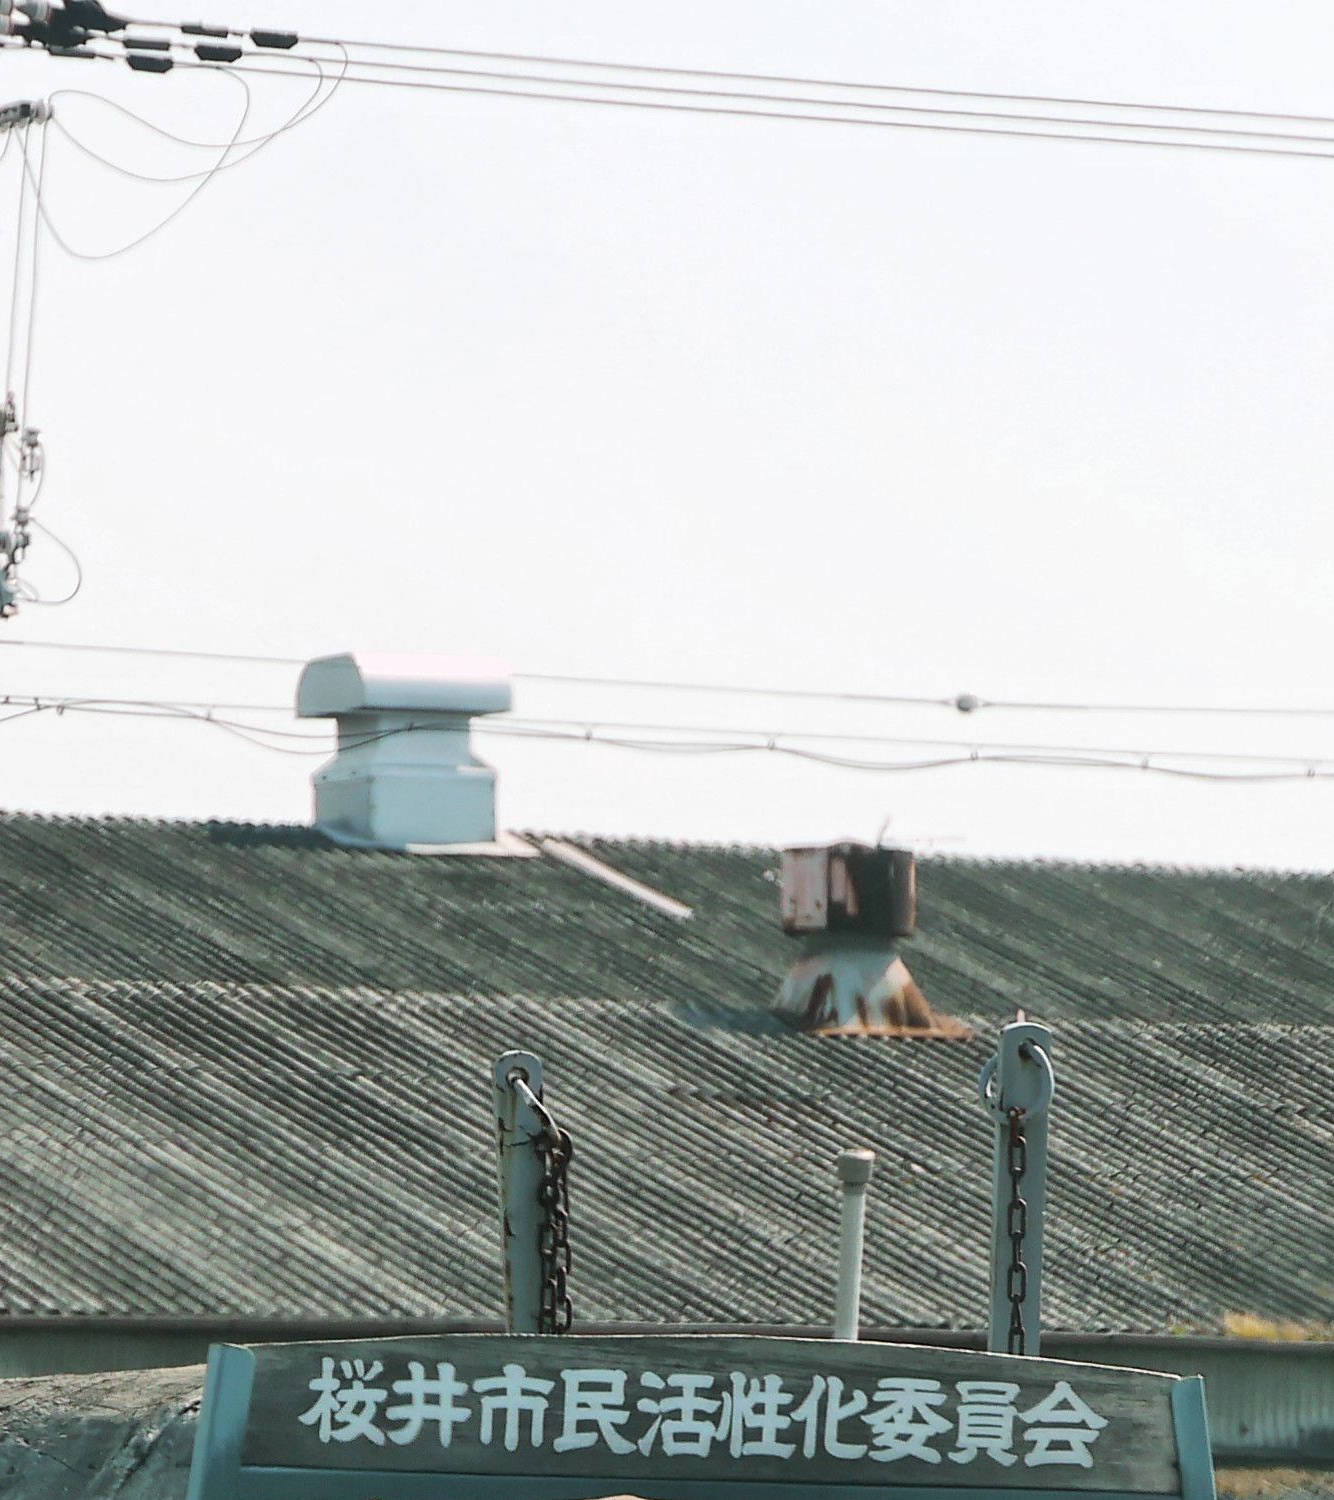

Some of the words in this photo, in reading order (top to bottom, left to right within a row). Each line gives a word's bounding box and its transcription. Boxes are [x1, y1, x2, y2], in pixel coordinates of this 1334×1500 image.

[299, 1358, 1108, 1468] 桜井市民活性化委員会
